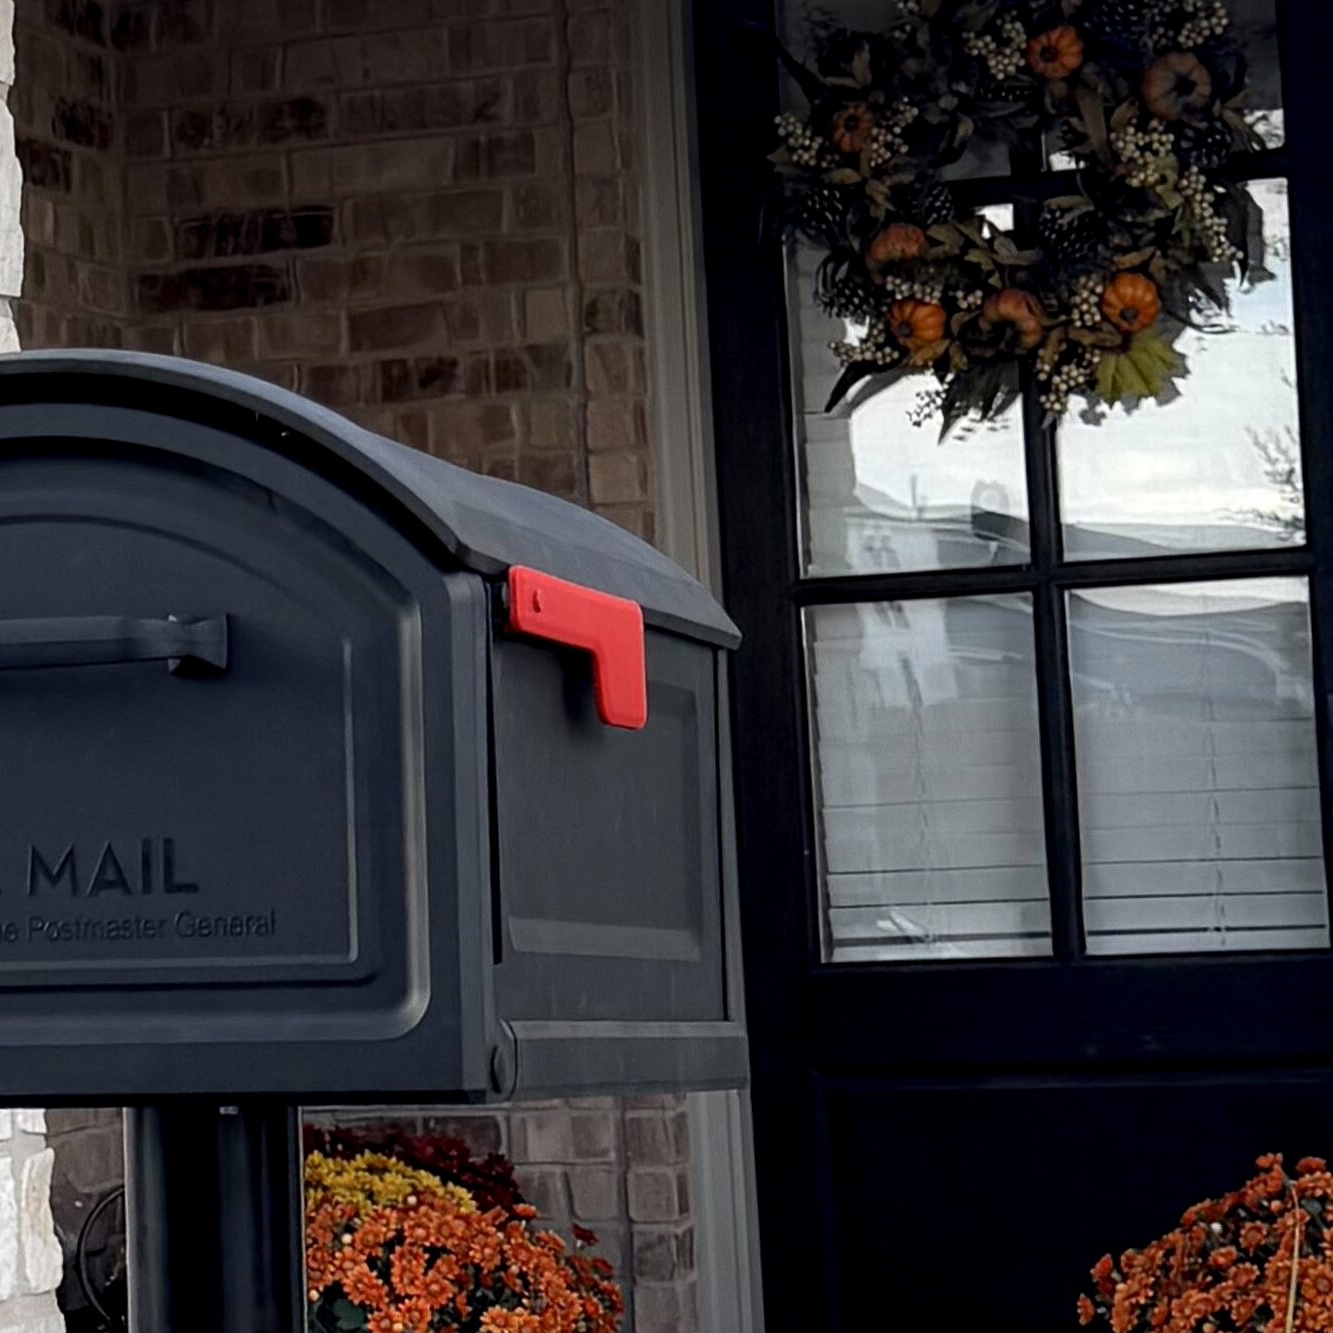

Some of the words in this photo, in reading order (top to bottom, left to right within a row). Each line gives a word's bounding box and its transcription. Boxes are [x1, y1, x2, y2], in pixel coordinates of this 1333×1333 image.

[26, 837, 201, 897] MAIL
[27, 911, 166, 943] Postmaster
[174, 908, 276, 938] General
